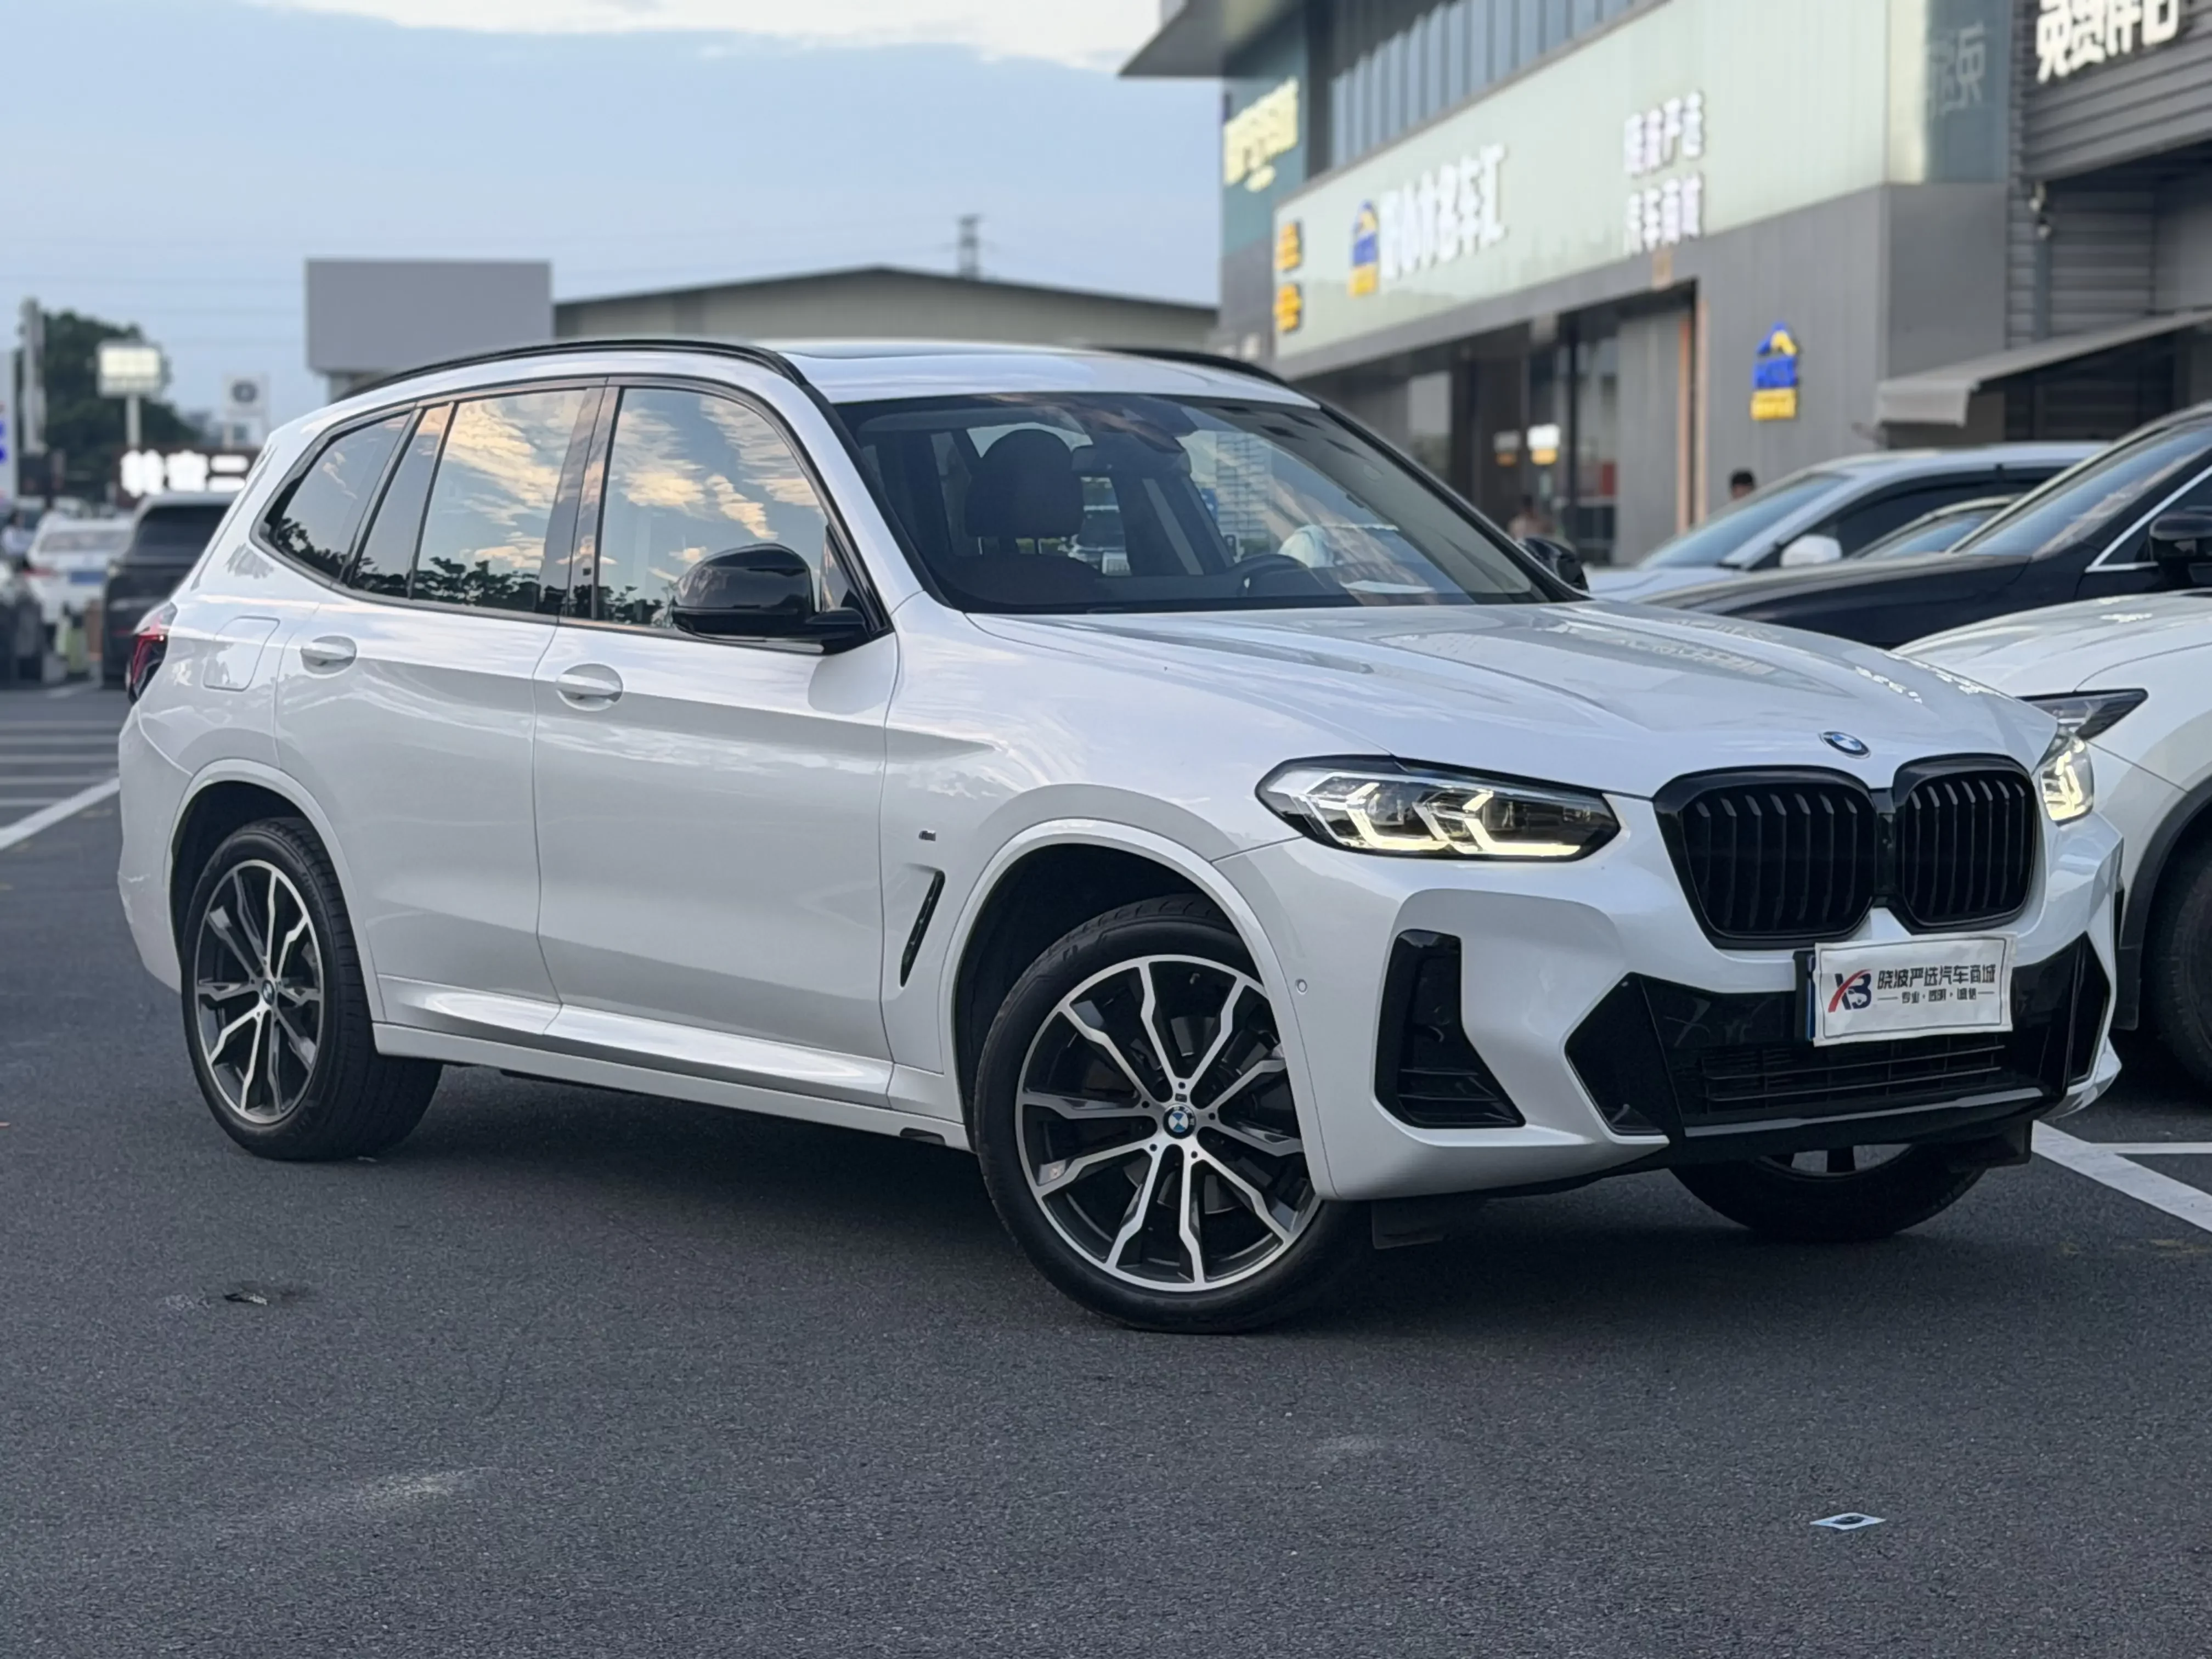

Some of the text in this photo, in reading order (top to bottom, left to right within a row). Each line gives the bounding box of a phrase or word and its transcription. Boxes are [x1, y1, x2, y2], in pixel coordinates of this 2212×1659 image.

[1877, 964, 1996, 990] 晓波严选汽车商城
